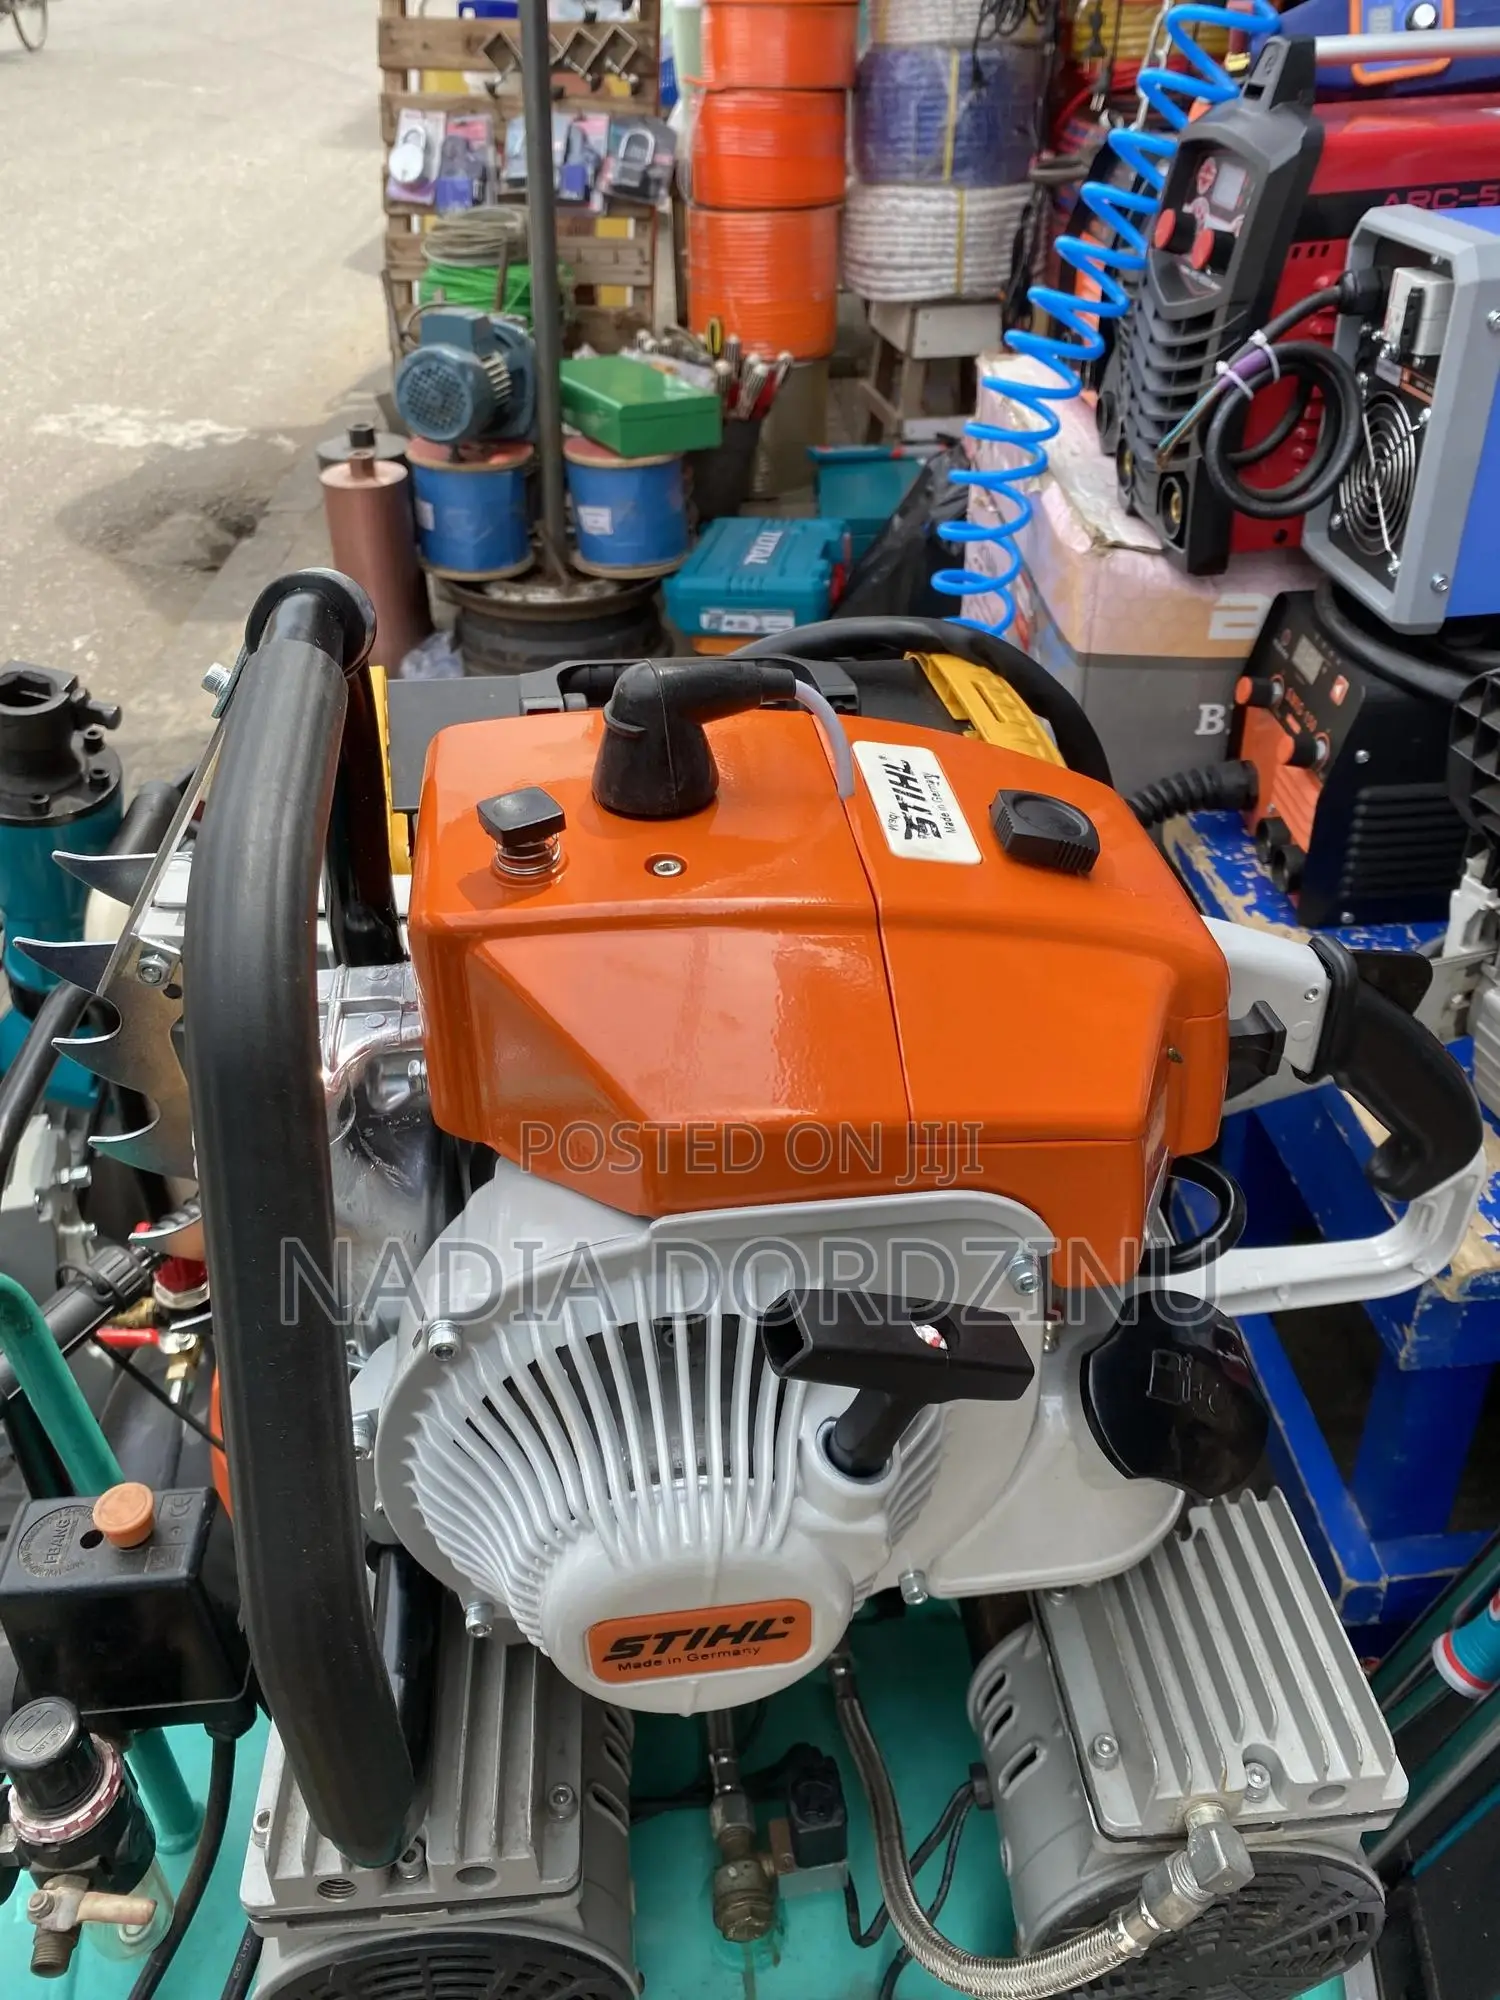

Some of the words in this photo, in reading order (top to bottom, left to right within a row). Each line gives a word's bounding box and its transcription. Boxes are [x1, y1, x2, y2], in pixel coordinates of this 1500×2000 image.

[882, 759, 942, 840] STIHL
[941, 812, 958, 834] Made
[602, 1616, 791, 1662] STIHL
[617, 1659, 663, 1672] Made
[667, 1654, 682, 1665] in
[686, 1646, 761, 1662] Germany
